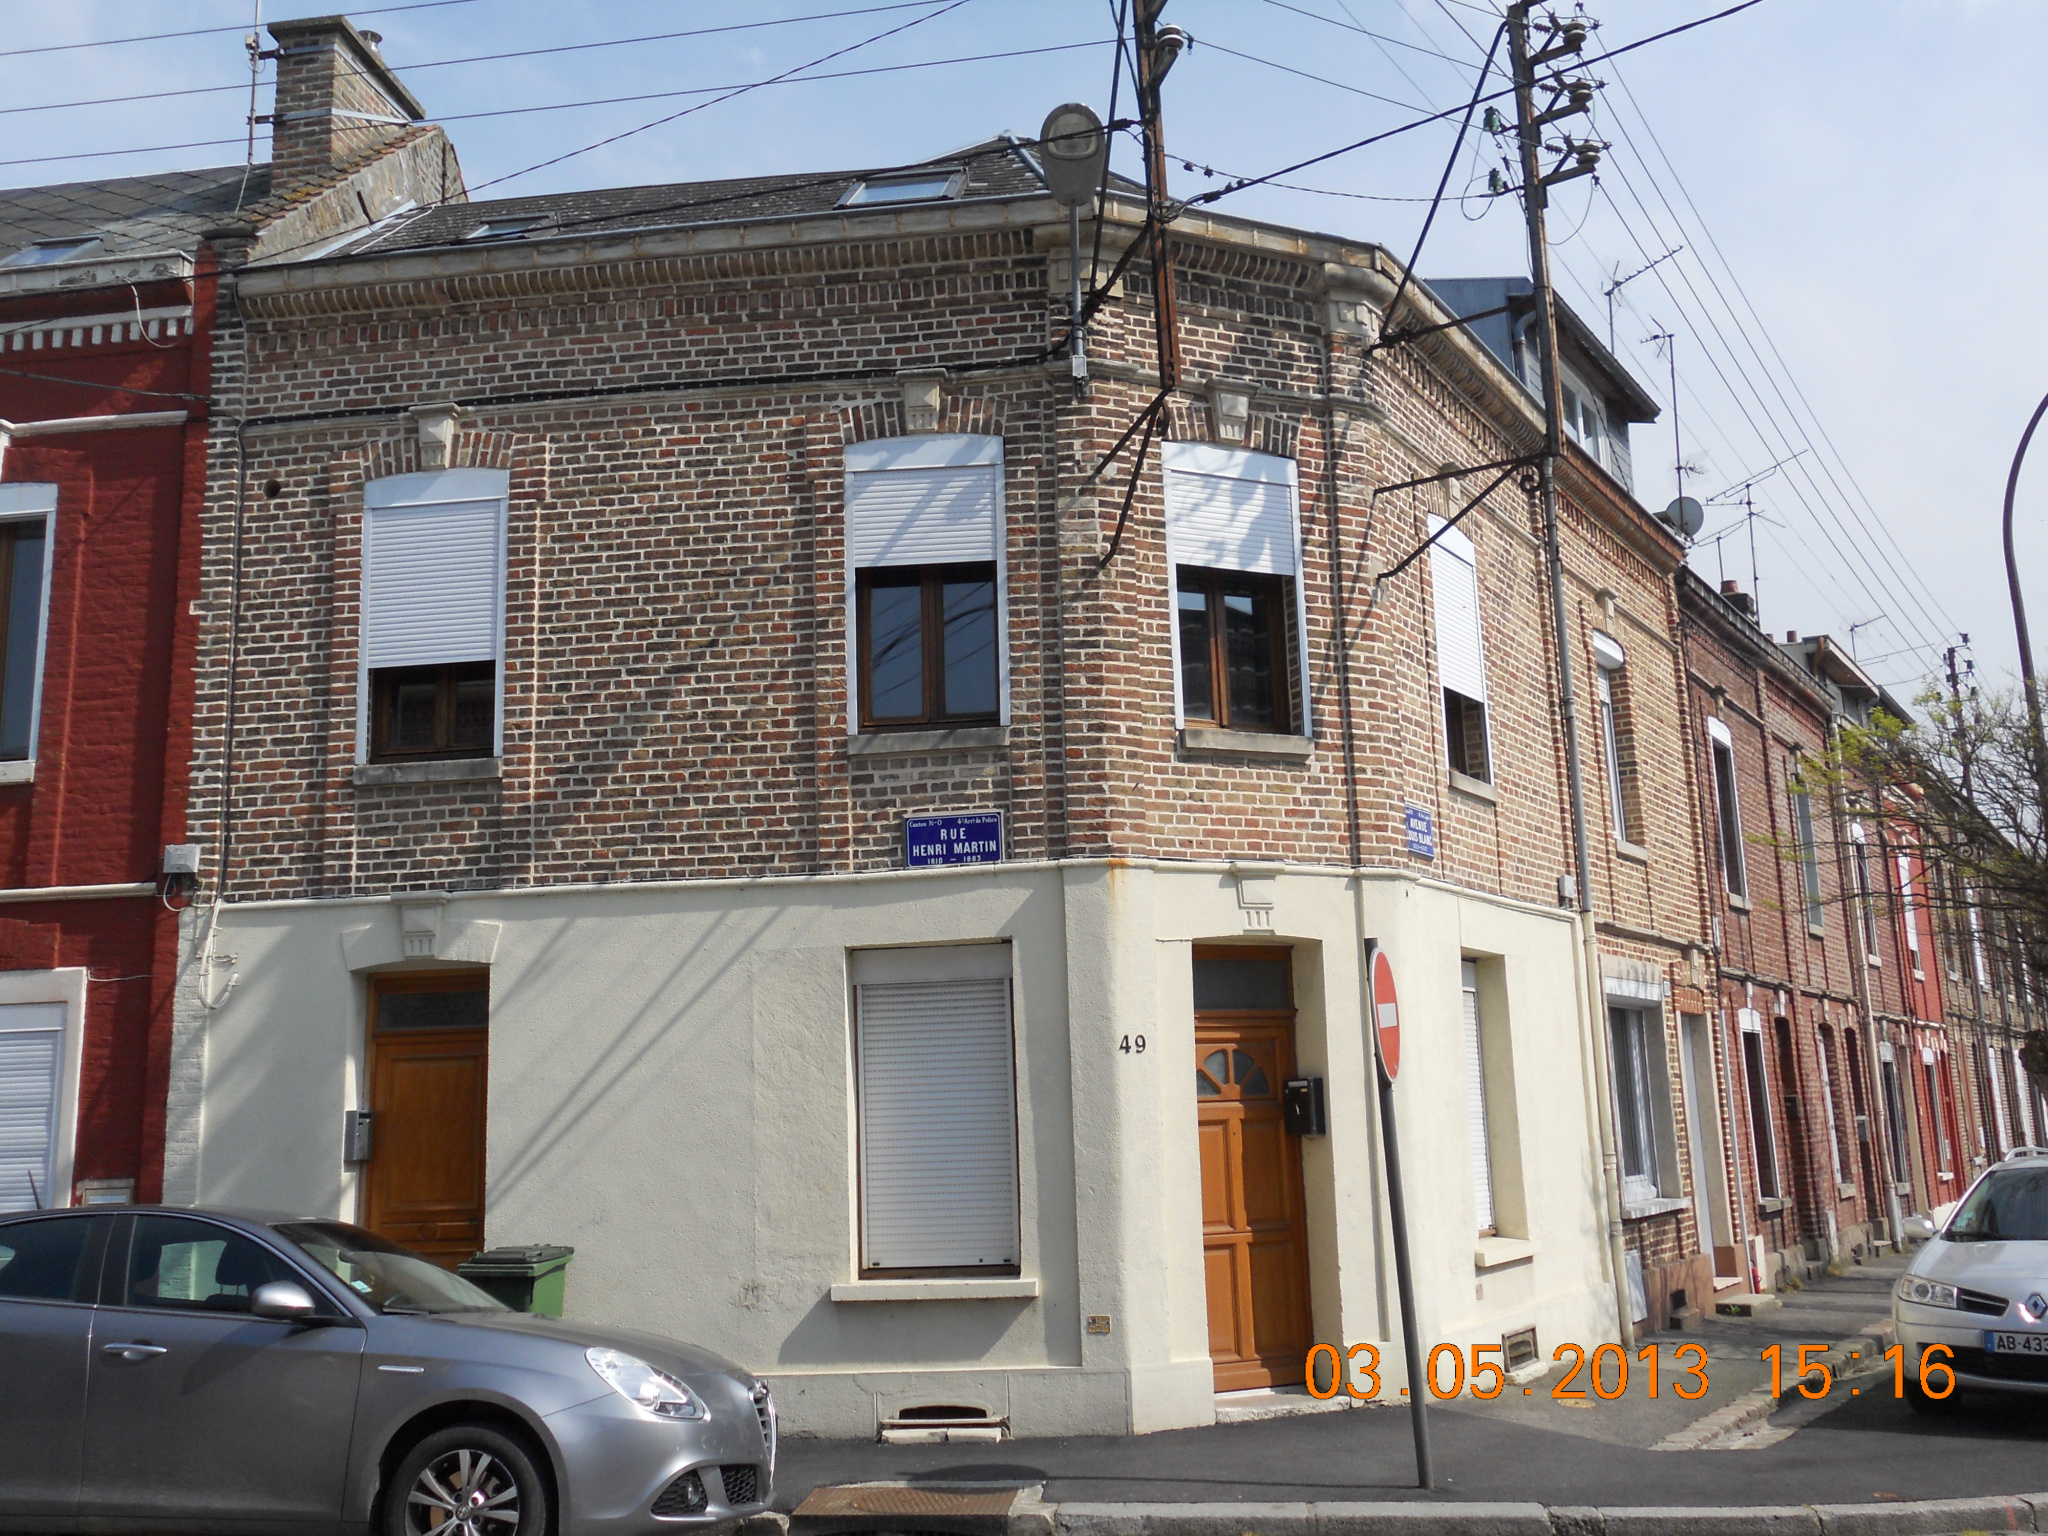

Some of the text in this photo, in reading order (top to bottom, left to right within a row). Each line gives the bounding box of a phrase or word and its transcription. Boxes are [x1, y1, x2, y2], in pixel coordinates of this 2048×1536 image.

[1410, 818, 1428, 832] AVENUE
[940, 828, 967, 840] RUE
[1418, 833, 1432, 846] BLANC
[913, 840, 997, 857] HENRI MARTIN
[927, 857, 943, 865] 1810
[1118, 1034, 1146, 1054] 49
